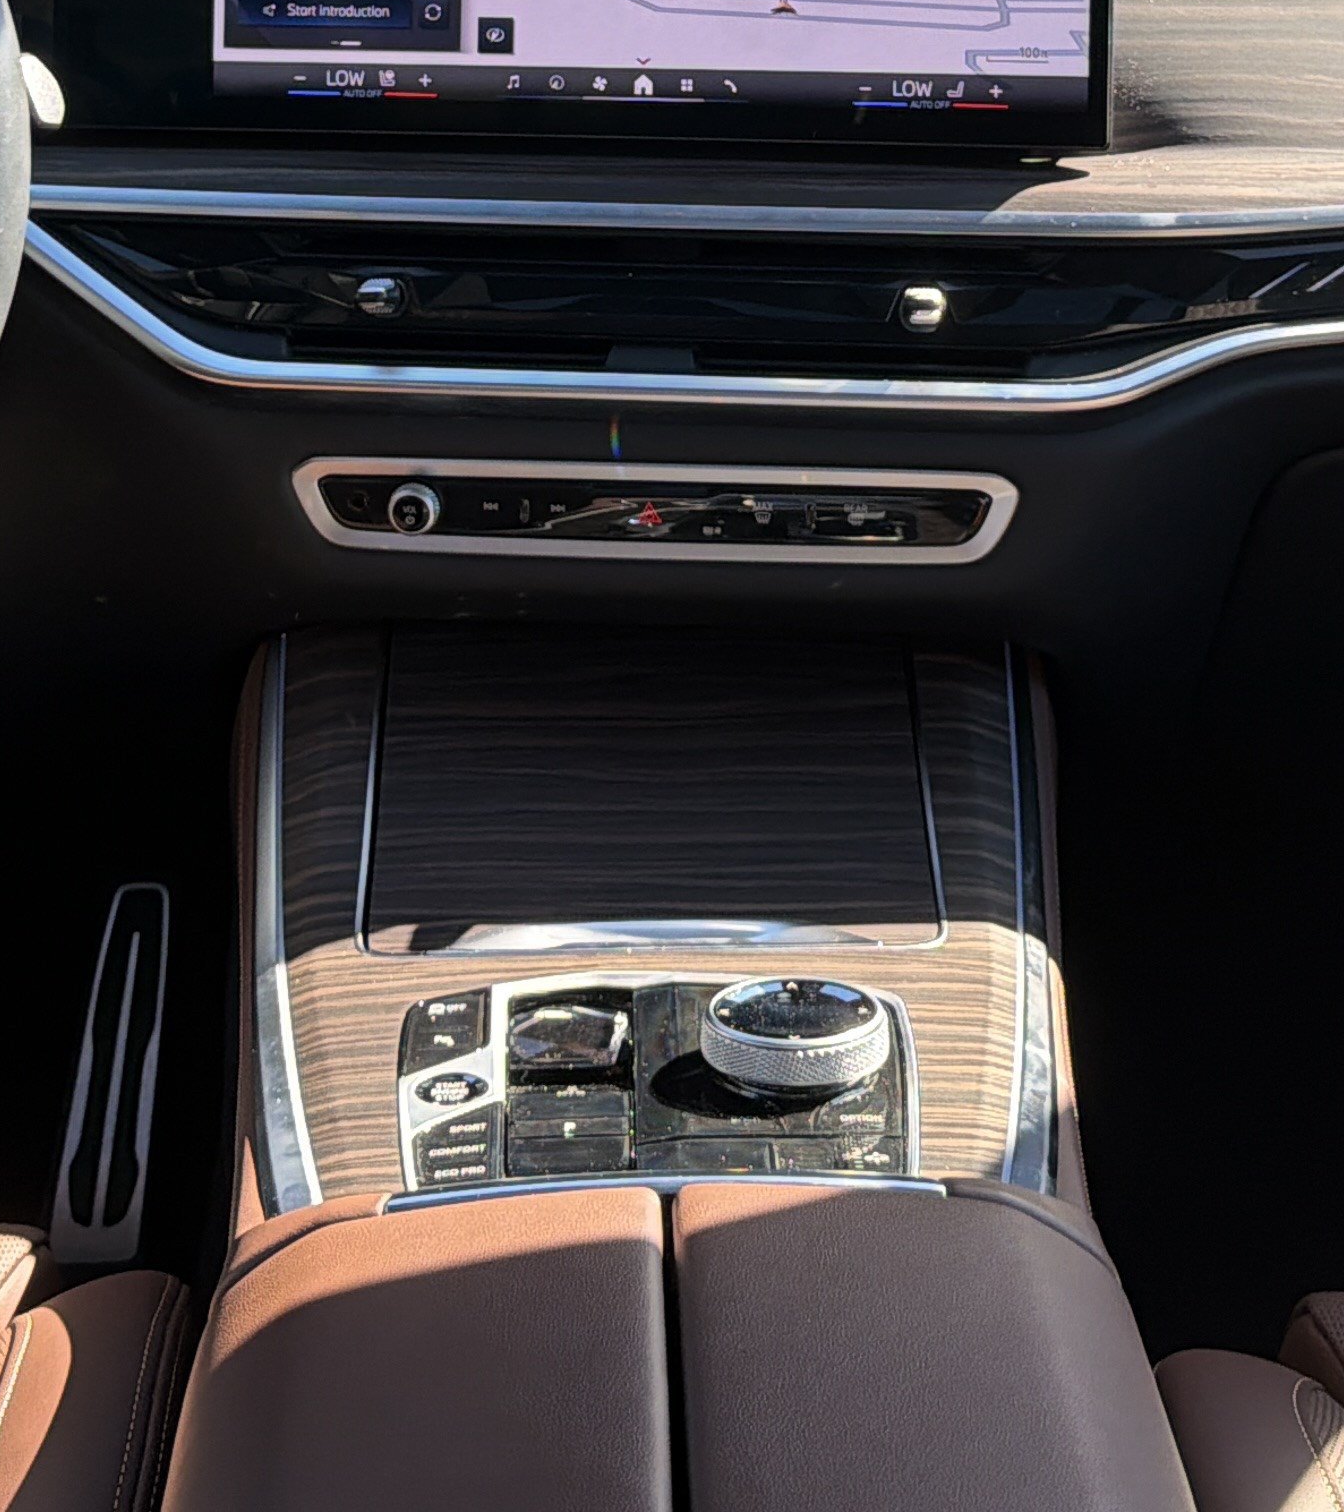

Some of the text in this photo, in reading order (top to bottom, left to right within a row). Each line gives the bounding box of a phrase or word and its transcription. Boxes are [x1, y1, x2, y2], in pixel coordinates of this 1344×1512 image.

[287, 3, 316, 17] Start
[326, 69, 365, 87] LOW
[343, 89, 382, 98] AUTO OFF
[892, 79, 933, 98] LOW
[910, 100, 950, 109] AUTO OFF
[843, 502, 868, 513] REAR
[839, 1114, 885, 1123] OPTION
[449, 1122, 487, 1134] SPORT
[428, 1143, 487, 1157] COMFORT
[434, 1165, 486, 1179] ECO PRO
